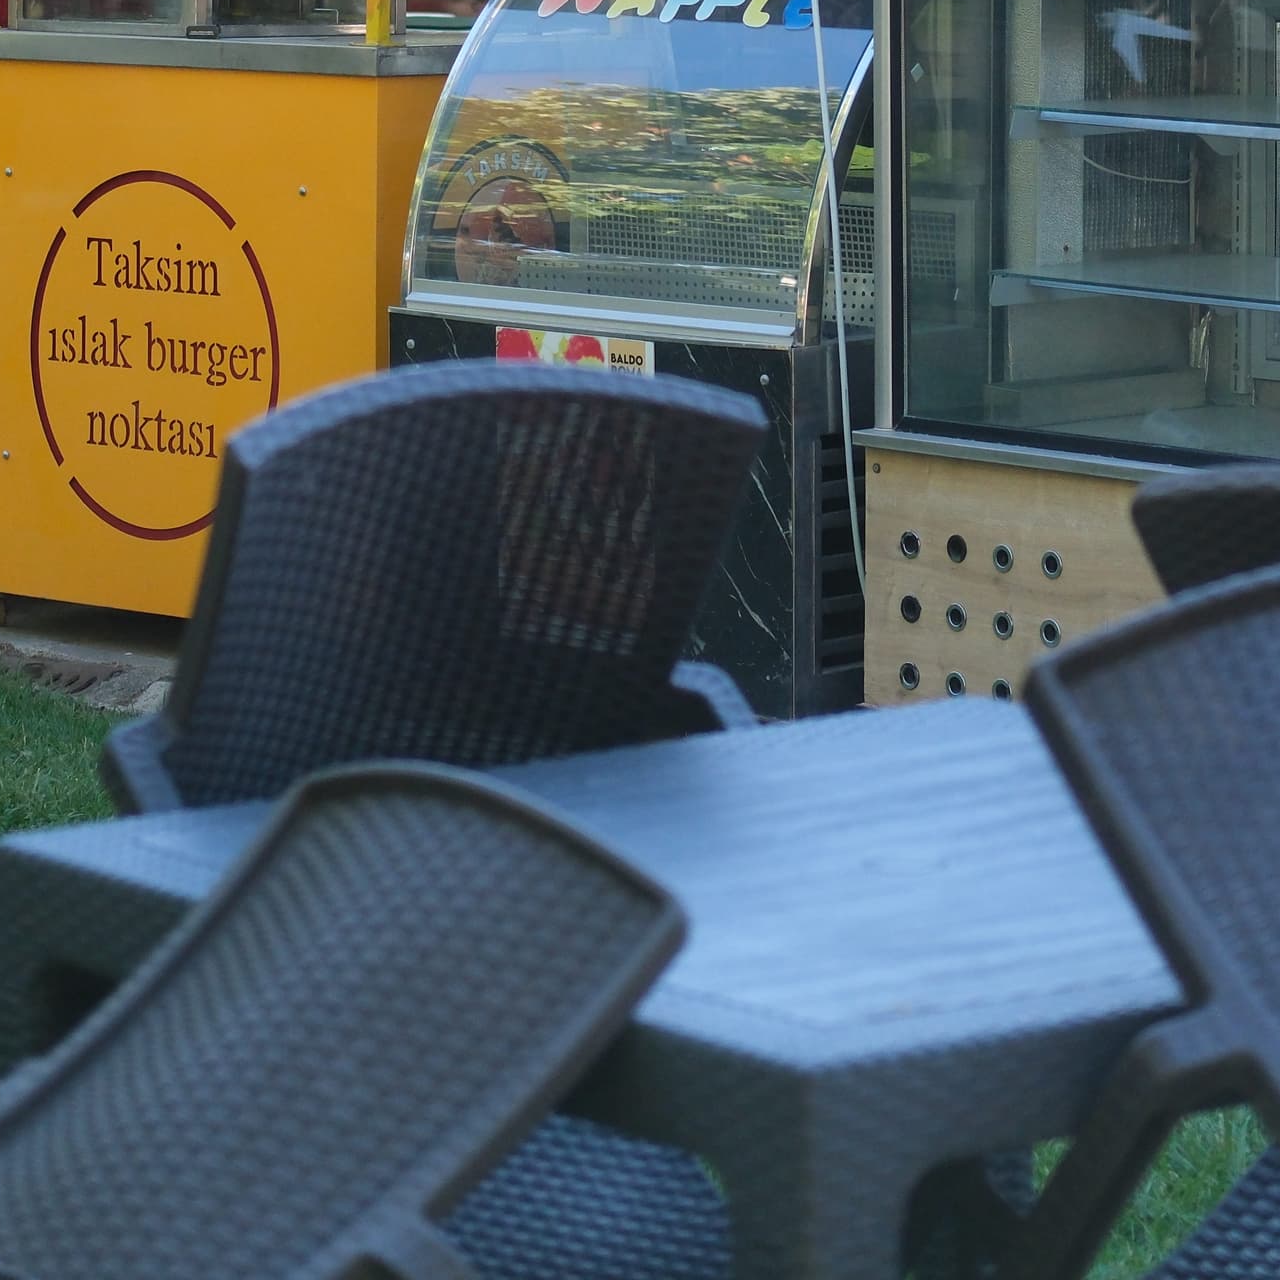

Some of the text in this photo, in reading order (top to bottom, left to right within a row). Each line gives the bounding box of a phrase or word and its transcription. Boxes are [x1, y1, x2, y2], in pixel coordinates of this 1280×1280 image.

[86, 237, 221, 297] Taksim
[145, 322, 266, 387] burger
[610, 352, 644, 366] BALDO
[86, 401, 218, 458] noktası
